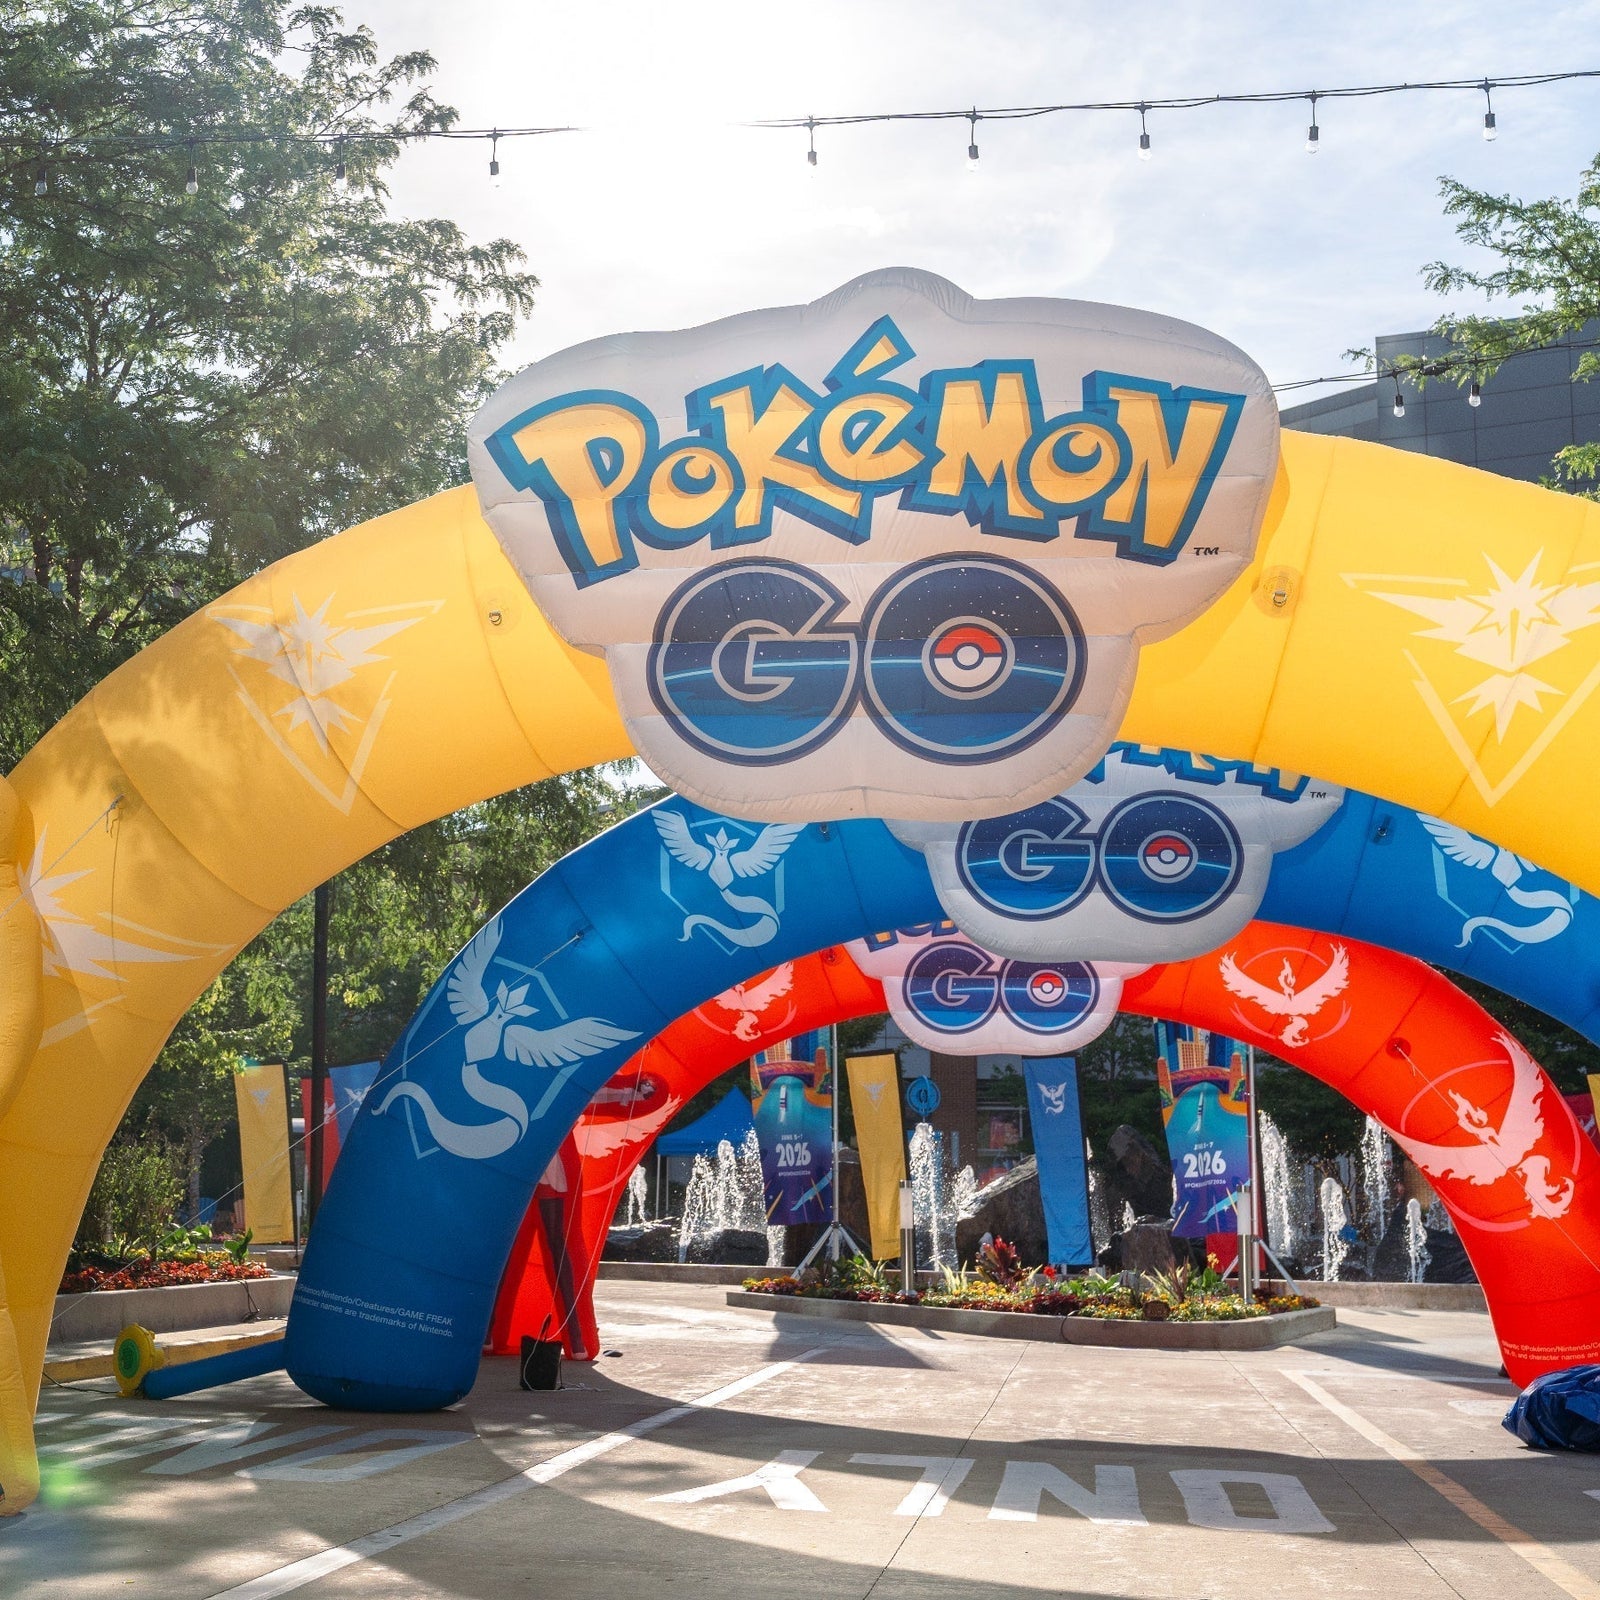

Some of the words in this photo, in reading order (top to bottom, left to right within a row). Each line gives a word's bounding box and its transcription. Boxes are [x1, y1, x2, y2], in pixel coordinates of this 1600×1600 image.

[646, 551, 1088, 768] GO
[955, 789, 1244, 925] GO
[902, 940, 1100, 1036] GO
[776, 1142, 811, 1166] 2026
[1183, 1150, 1226, 1178] 2026
[320, 1302, 343, 1313] names
[344, 1308, 357, 1317] are
[358, 1311, 406, 1328] trademarks
[408, 1322, 418, 1331] of
[418, 1321, 454, 1338] Nintendo.
[425, 1313, 453, 1326] FREAK
[646, 1449, 1338, 1533] ONLY
